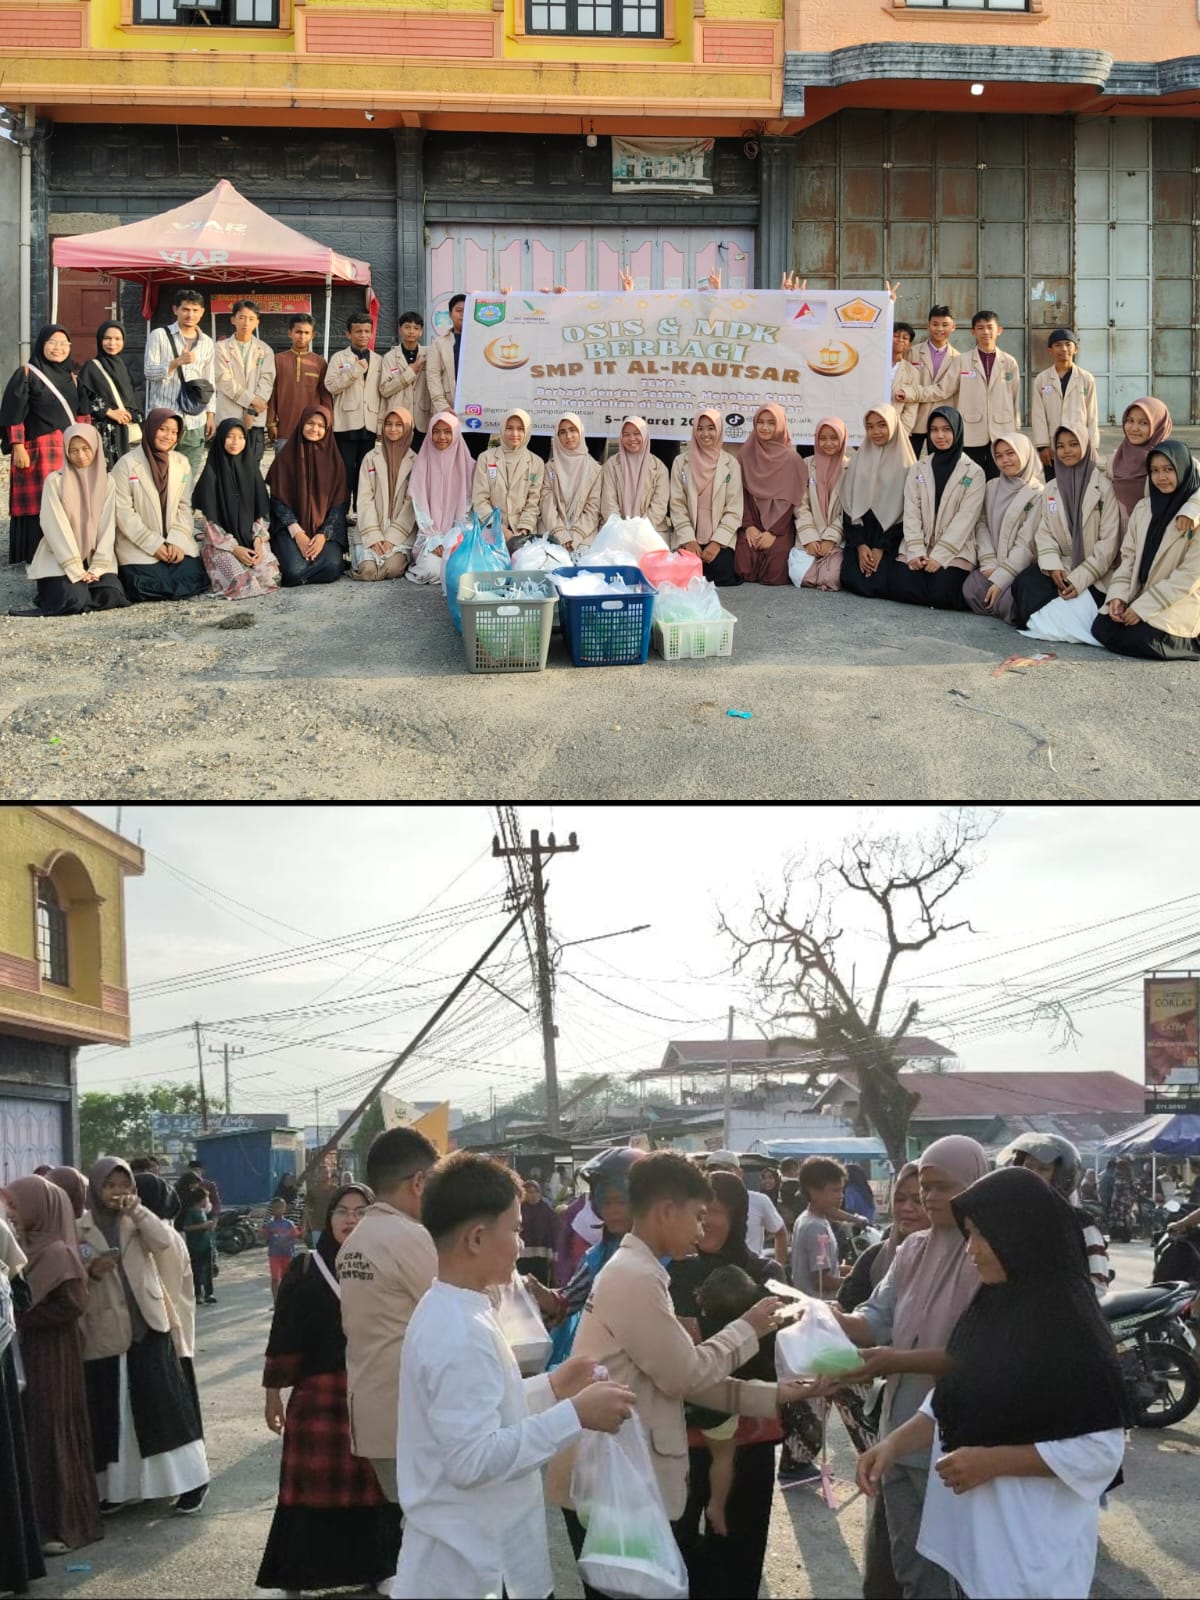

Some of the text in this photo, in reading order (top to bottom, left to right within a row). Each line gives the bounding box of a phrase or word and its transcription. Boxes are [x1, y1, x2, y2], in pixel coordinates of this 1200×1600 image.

[172, 220, 248, 233] VIAR
[159, 249, 229, 266] VIAR
[562, 317, 780, 344] OSIS & MPK
[584, 339, 749, 362] BERBAGI
[530, 360, 800, 384] SMP IT AL-KAUTSAR
[640, 378, 675, 388] TEMA
[536, 387, 585, 398] Berbagi
[590, 387, 637, 398] dengan
[702, 391, 760, 401] Menebar
[764, 393, 801, 402] Cinta
[533, 398, 557, 407] dan
[561, 399, 634, 410] Kepedulian
[639, 400, 651, 409] di
[655, 400, 693, 410] Bulan
[699, 402, 726, 412] Suci
